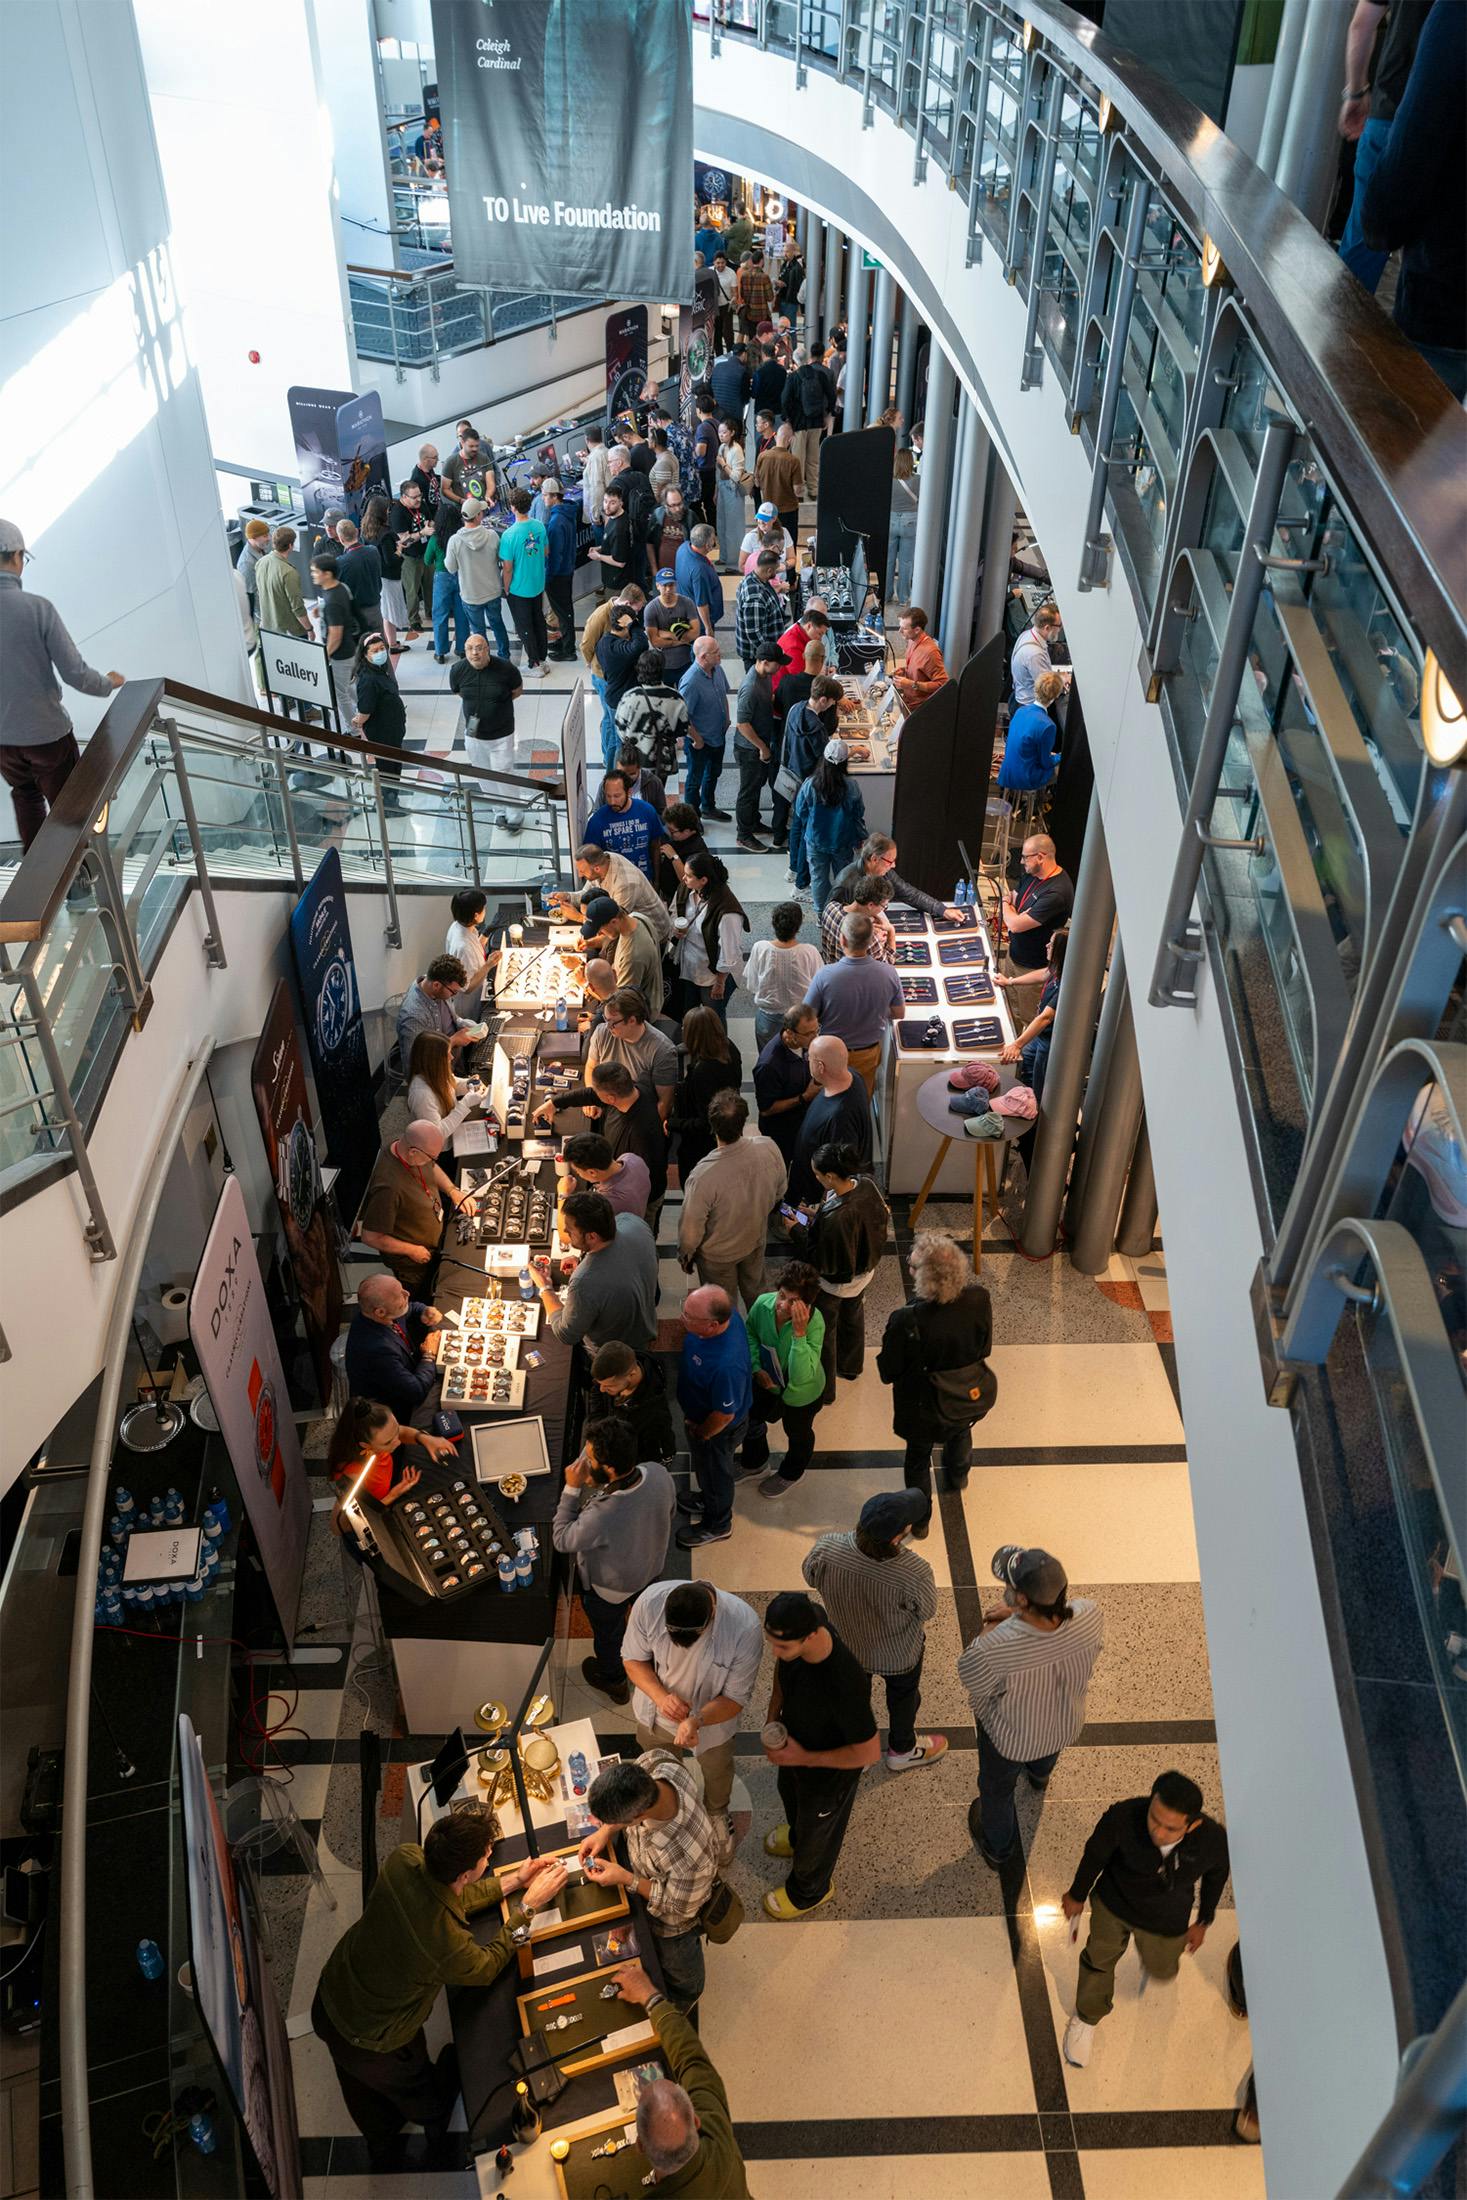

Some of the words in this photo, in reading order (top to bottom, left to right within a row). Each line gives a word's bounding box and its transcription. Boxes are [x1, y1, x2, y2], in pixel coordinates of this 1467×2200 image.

[476, 38, 511, 54] Celeigh
[477, 56, 521, 70] Cardinal
[482, 196, 509, 222] TO
[512, 198, 549, 225] Live
[554, 201, 661, 231] Foundation
[275, 658, 318, 687] Gallery
[602, 828, 612, 837] MY
[613, 825, 633, 836] SPARE
[634, 823, 648, 832] TIME
[210, 1236, 242, 1340] DOXA
[170, 1540, 180, 1566] DOXA
